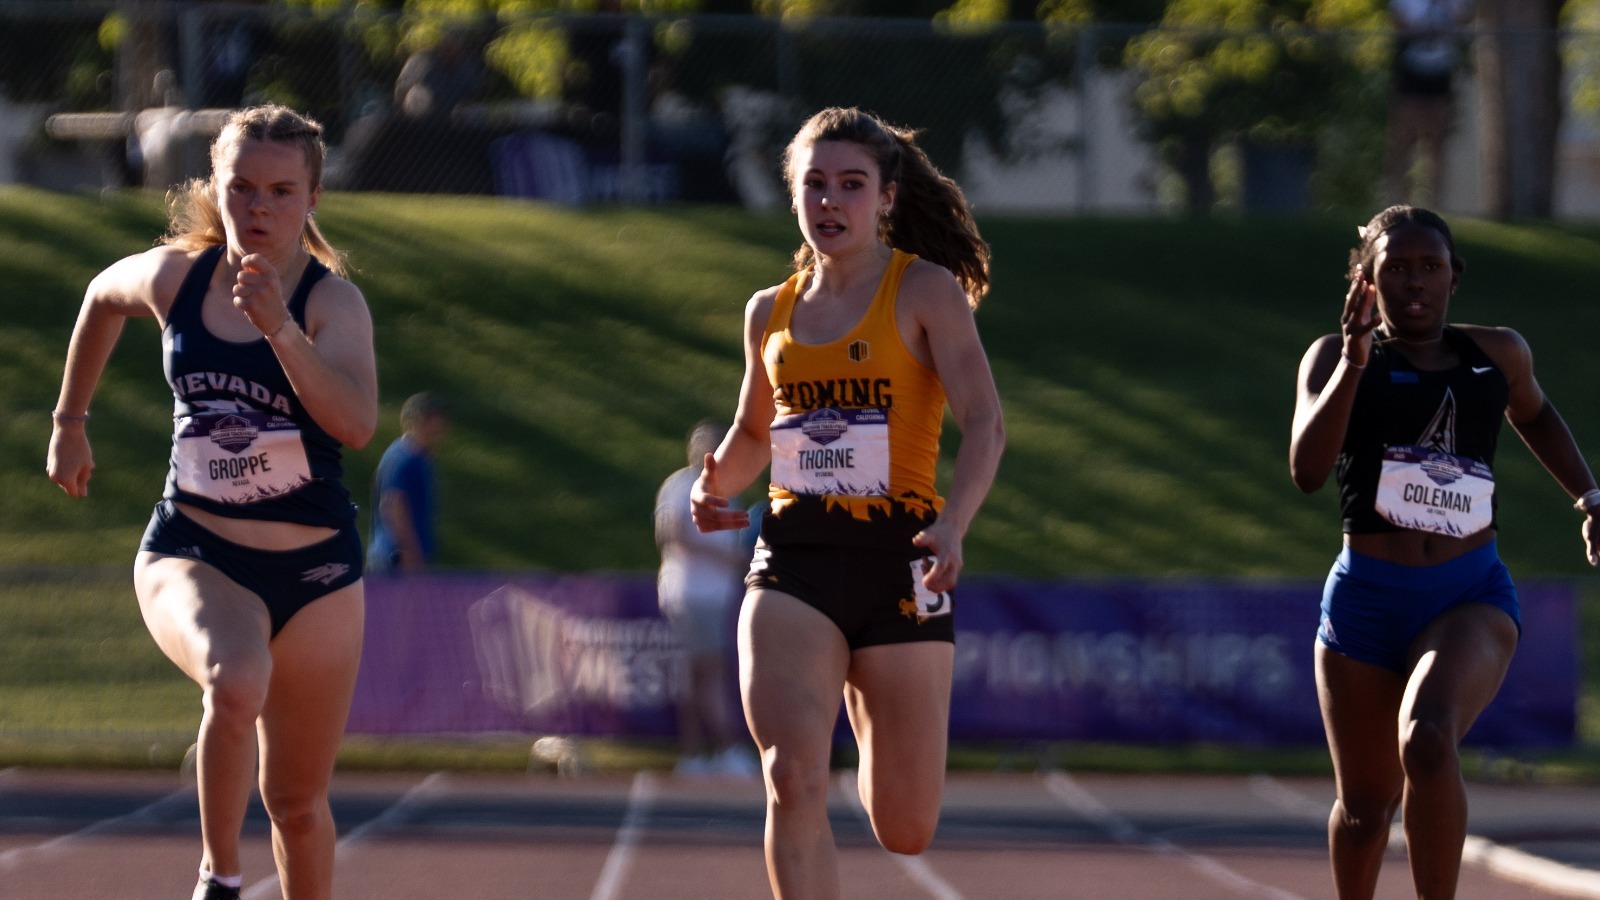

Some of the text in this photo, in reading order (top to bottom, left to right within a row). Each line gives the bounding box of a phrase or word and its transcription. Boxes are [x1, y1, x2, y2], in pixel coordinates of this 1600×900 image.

[209, 452, 271, 480] GROPPE
[798, 448, 854, 470] THORNE
[232, 479, 250, 487] NEVADA
[1404, 483, 1472, 513] COLEMAN
[953, 632, 1293, 694] PIONSHIPS
